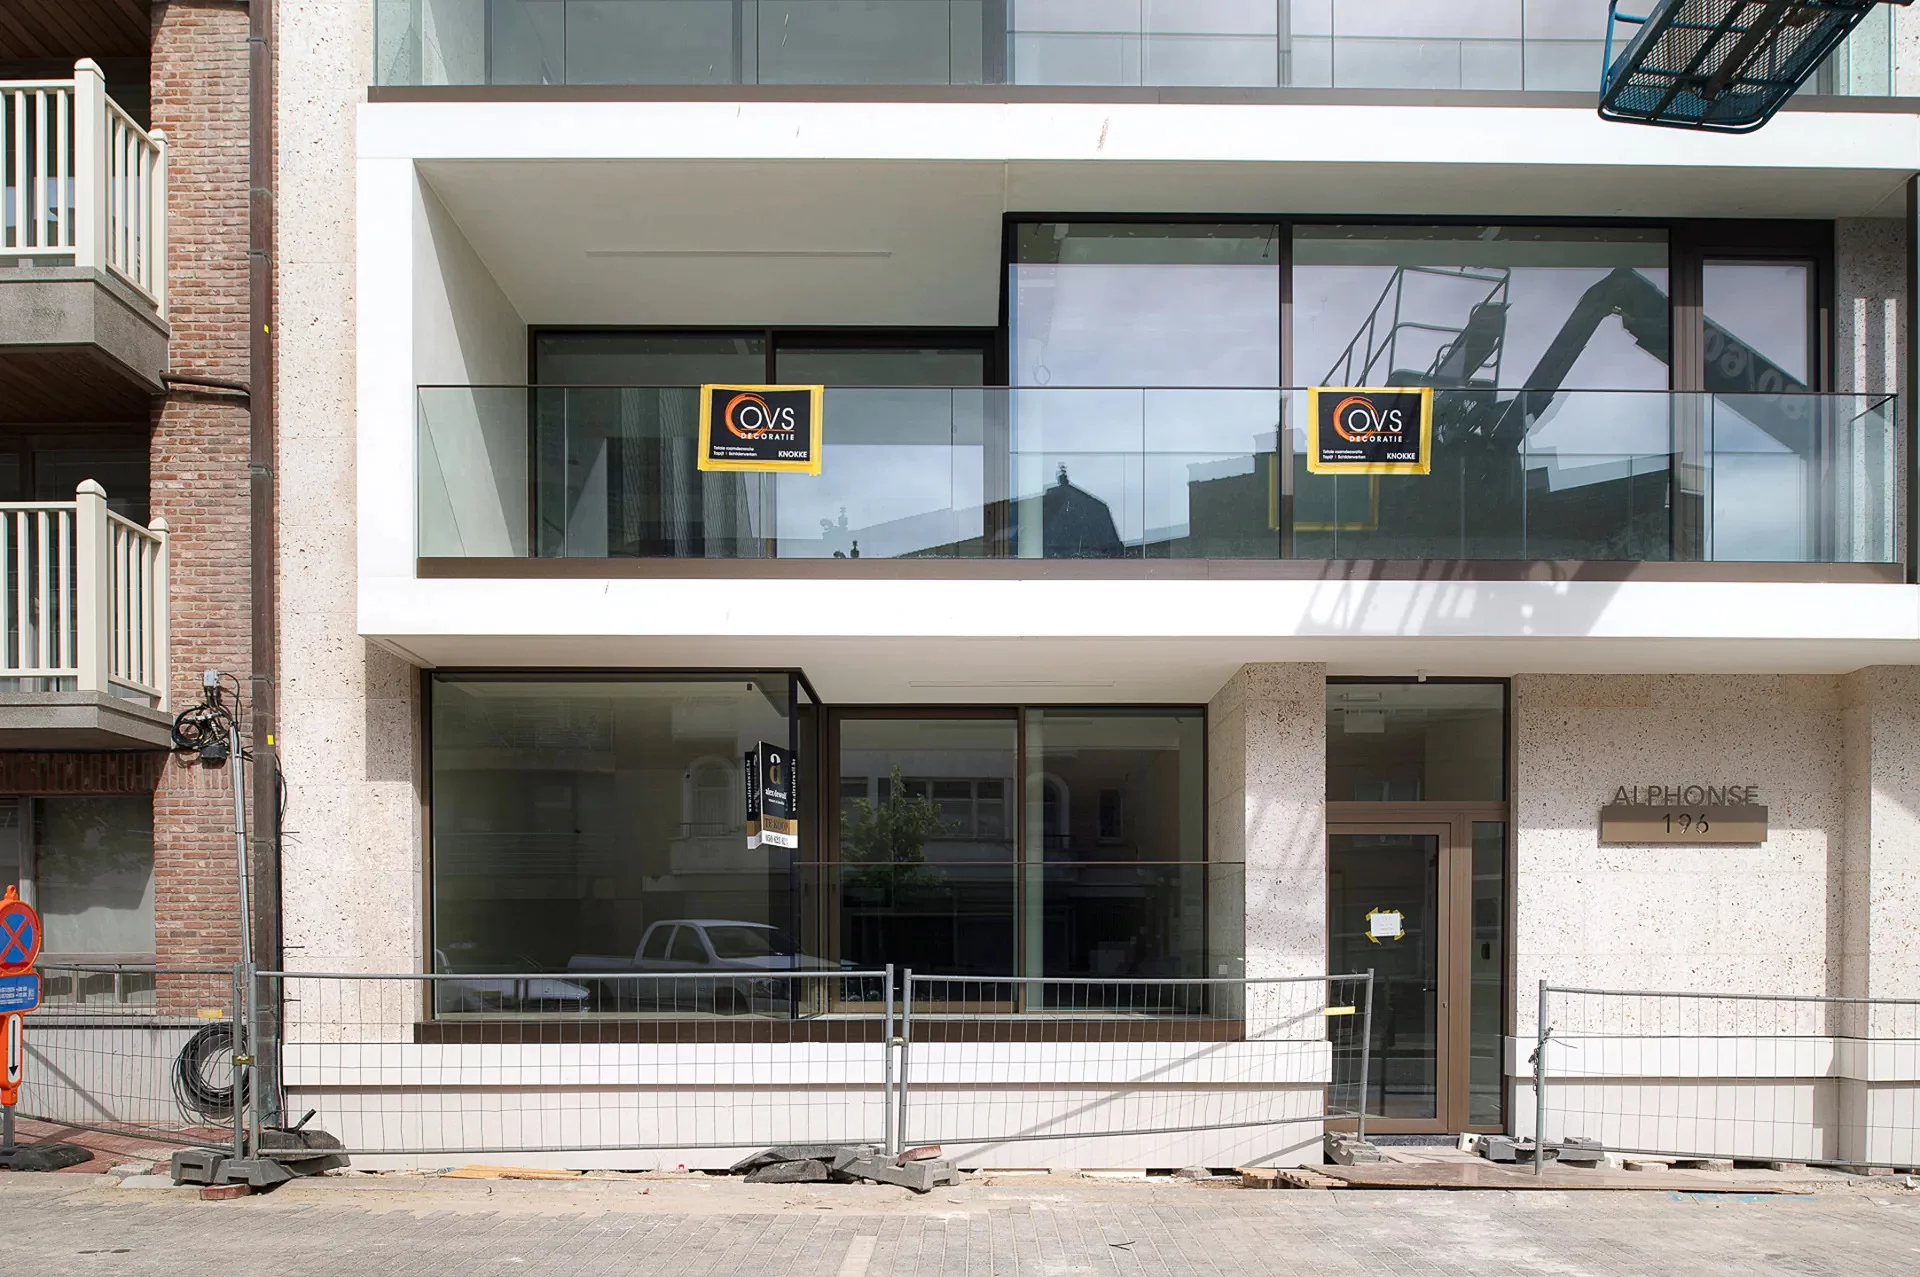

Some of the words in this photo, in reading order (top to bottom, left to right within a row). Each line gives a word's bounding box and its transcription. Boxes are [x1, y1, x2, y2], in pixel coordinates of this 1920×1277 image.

[740, 406, 795, 430] OVS
[1348, 409, 1403, 432] OVS
[778, 450, 808, 458] KNOKKE
[1386, 452, 1416, 460] KNOKKE
[1612, 785, 1760, 806] ALPHONSE
[1662, 813, 1709, 834] 196
